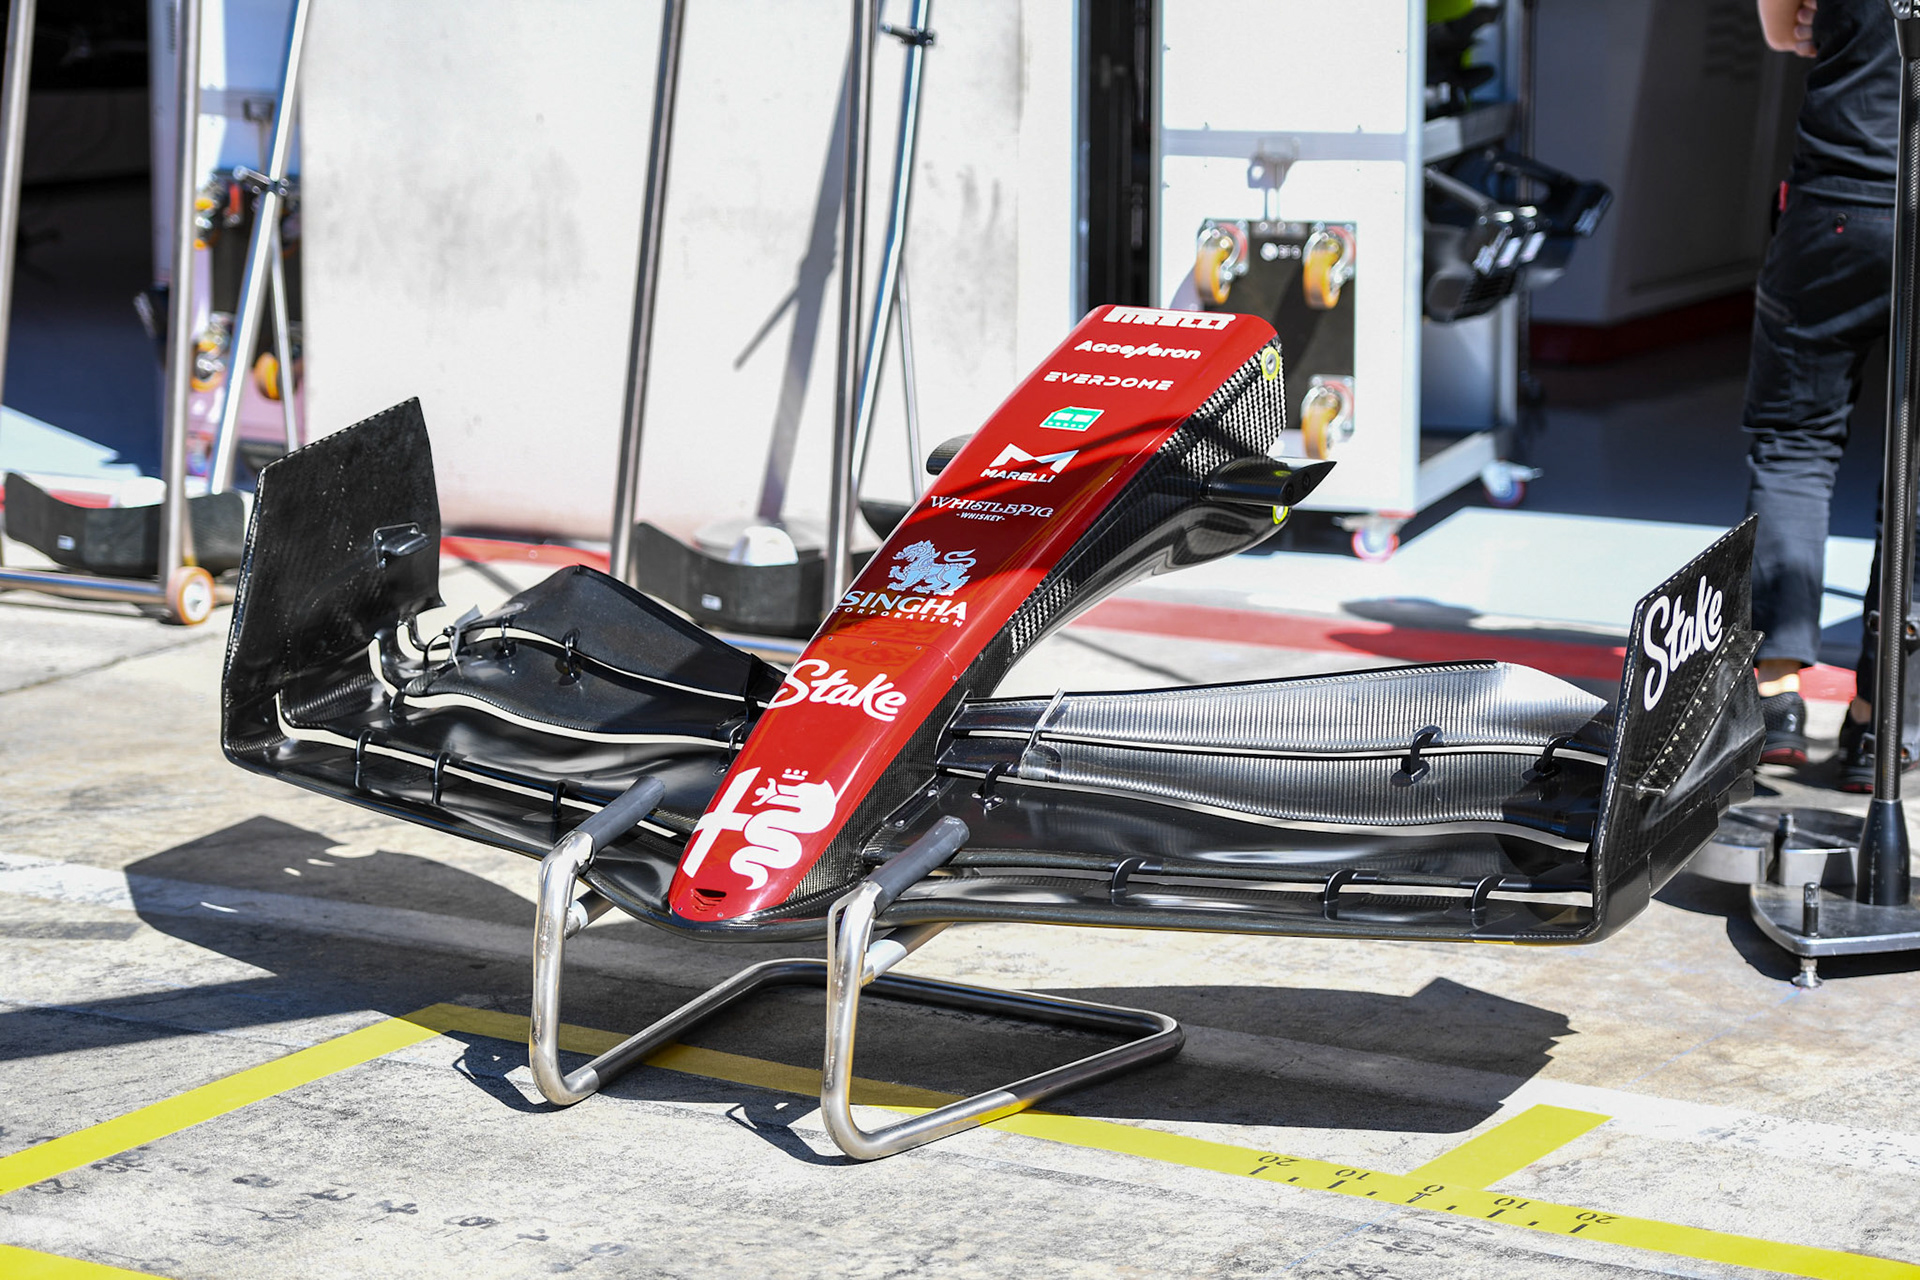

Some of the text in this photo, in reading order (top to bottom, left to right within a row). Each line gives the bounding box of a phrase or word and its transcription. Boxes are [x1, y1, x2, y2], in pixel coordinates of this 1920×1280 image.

[1103, 306, 1236, 330] PIRELLI
[1044, 371, 1174, 391] EVERDOME
[980, 468, 1056, 483] MARELLI
[840, 590, 967, 621] SINGHA
[833, 606, 963, 628] CORPORATION
[1643, 575, 1723, 711] Stake
[767, 659, 907, 722] Stake
[1258, 1154, 1300, 1167] 20
[1335, 1168, 1371, 1181] 10
[1493, 1197, 1530, 1210] 10
[1575, 1212, 1621, 1225] 20
